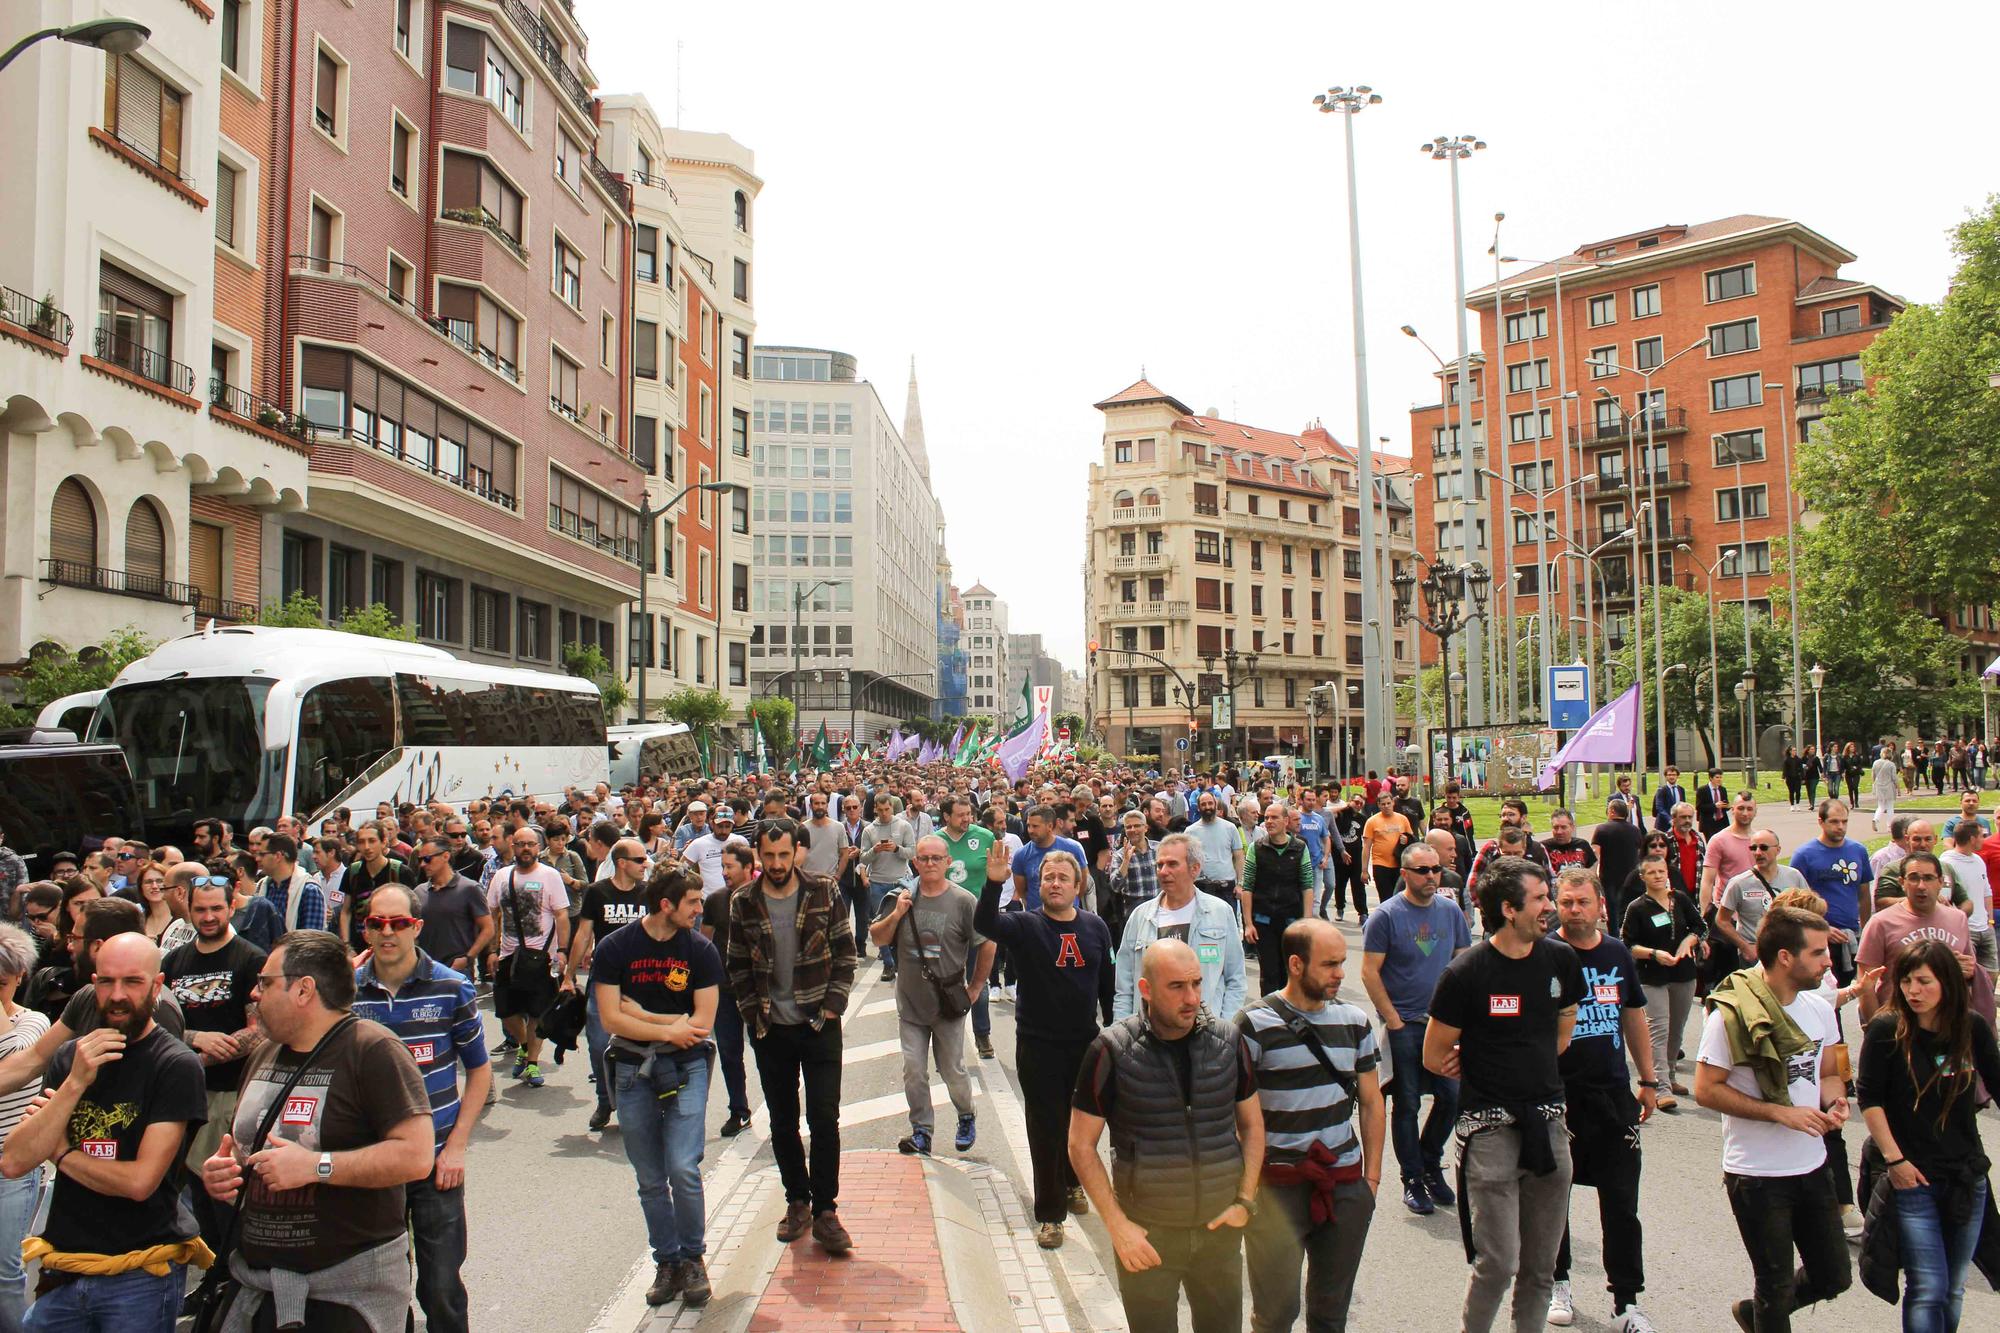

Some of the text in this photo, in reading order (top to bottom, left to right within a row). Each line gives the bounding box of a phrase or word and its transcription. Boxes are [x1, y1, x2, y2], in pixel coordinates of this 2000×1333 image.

[1900, 926, 1959, 947] DETROIT
[1056, 933, 1086, 967] A
[1597, 988, 1616, 997] LAB
[1493, 999, 1517, 1009] LAB
[411, 1045, 432, 1057] AB
[302, 1073, 333, 1086] FESTIVAL
[286, 1102, 312, 1115] LAB
[85, 1144, 114, 1157] LAB
